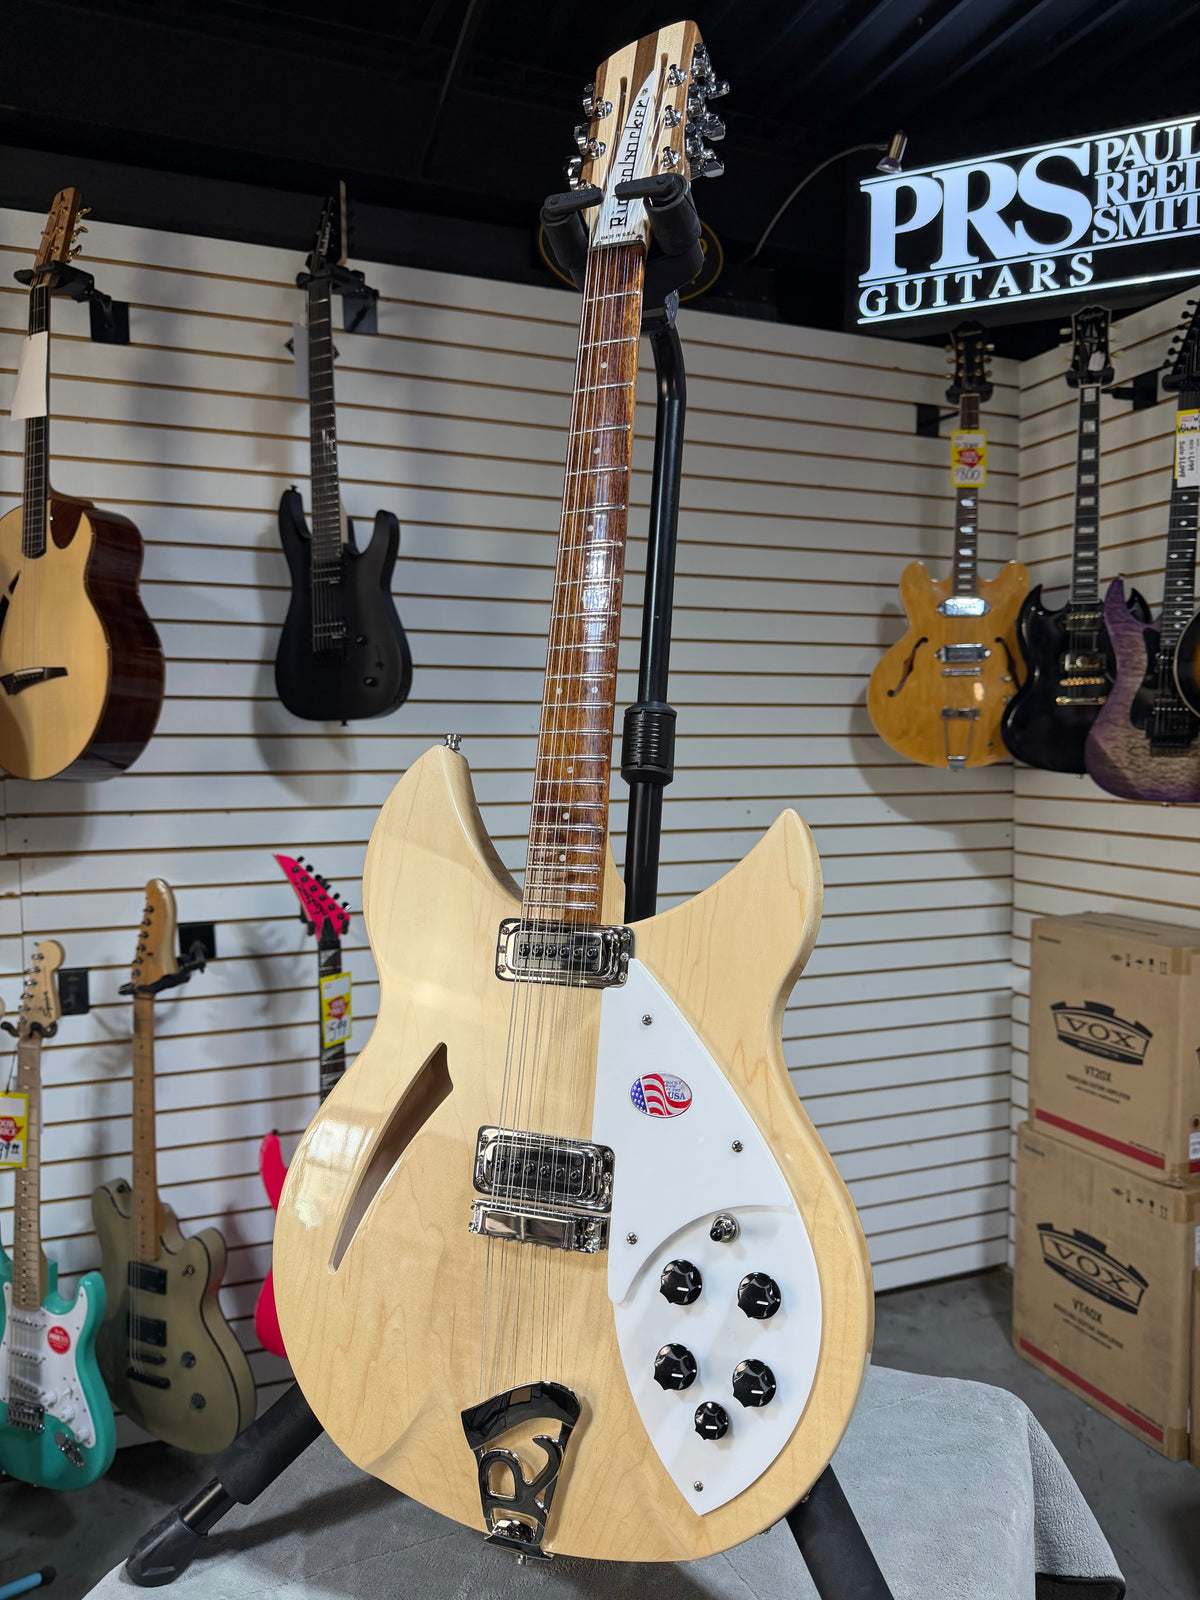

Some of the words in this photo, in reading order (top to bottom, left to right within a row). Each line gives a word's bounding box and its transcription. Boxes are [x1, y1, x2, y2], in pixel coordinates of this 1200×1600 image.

[610, 98, 649, 229] Ricenbacker
[1094, 122, 1200, 175] PAUL
[859, 142, 1092, 281] PRS
[858, 251, 1094, 317] GUITARS
[1062, 1014, 1136, 1051] VOX
[667, 1091, 686, 1101] USA
[1047, 1238, 1130, 1296] VOX
